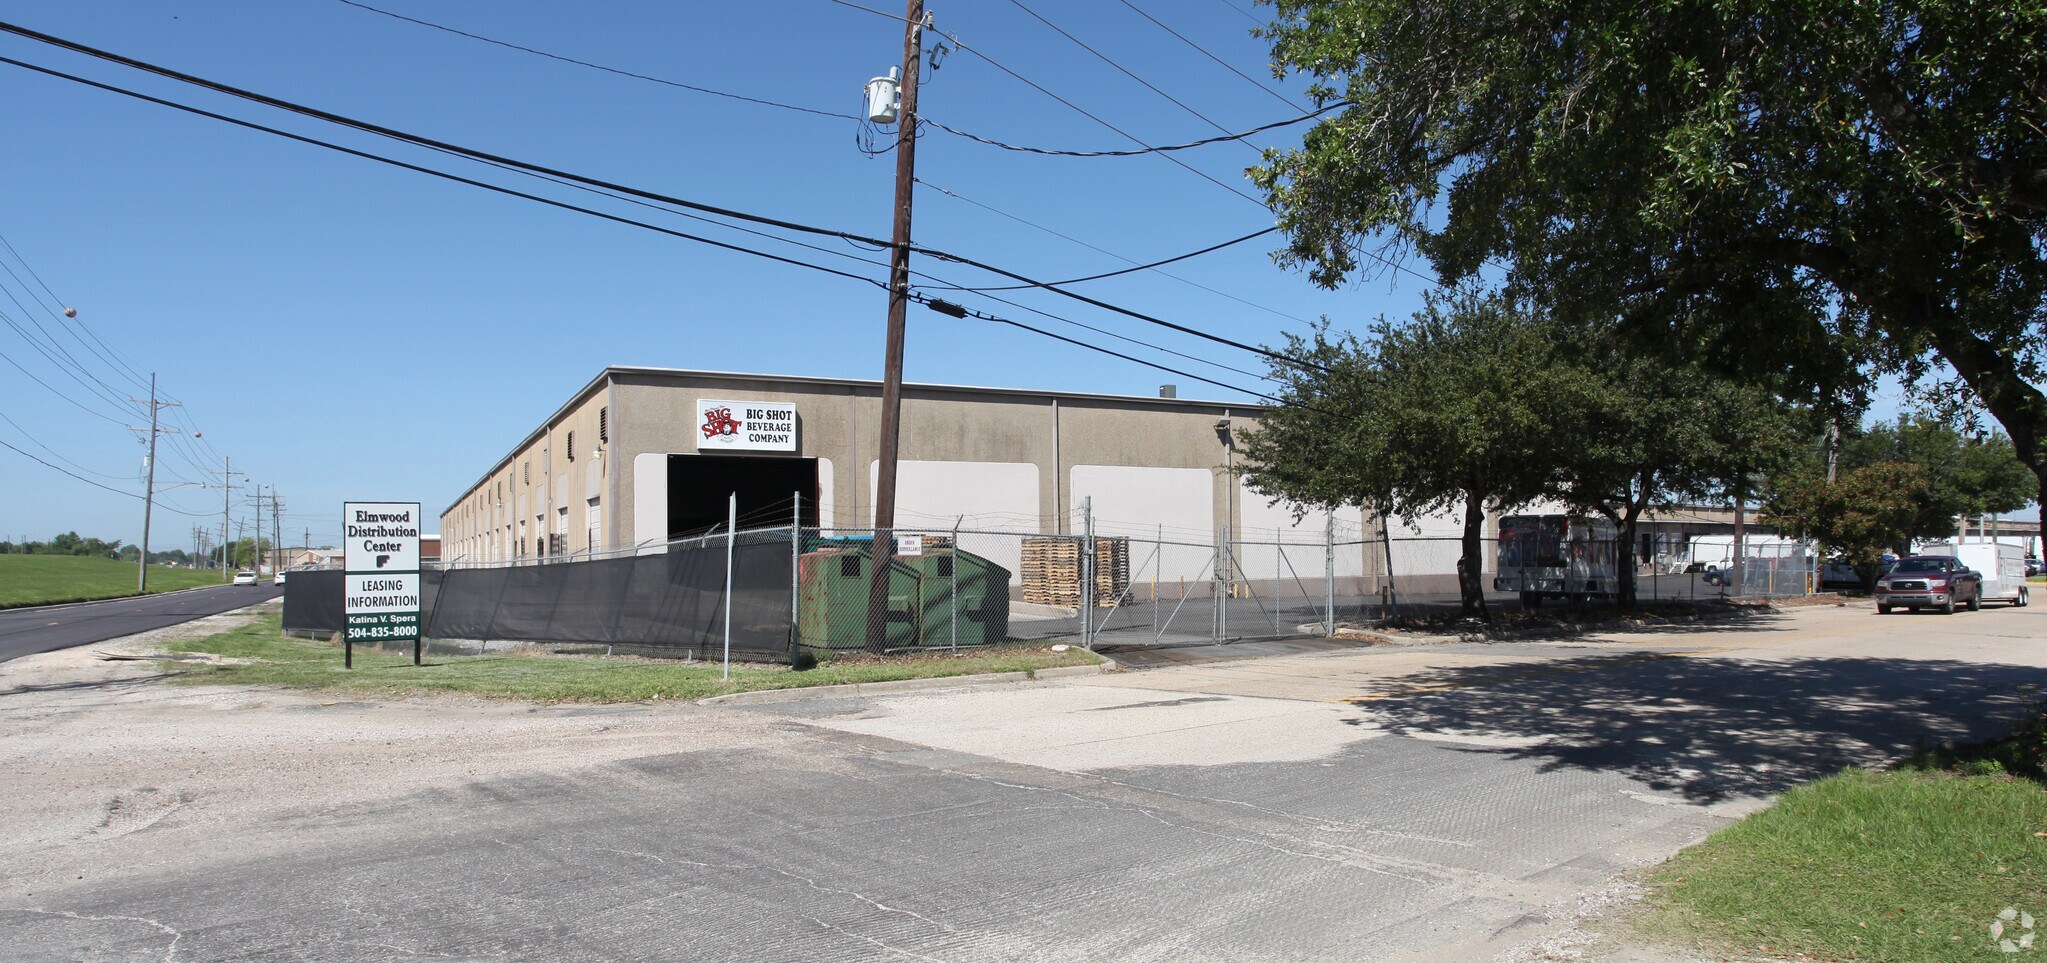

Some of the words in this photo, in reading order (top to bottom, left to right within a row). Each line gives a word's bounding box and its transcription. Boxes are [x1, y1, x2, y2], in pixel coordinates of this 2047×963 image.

[704, 408, 731, 422] BIG
[746, 409, 763, 420] BIG
[766, 409, 792, 420] SHOT
[701, 418, 742, 439] SHOT
[747, 422, 792, 432] BEVERAGE
[749, 433, 789, 443] COMPANY
[356, 510, 409, 522] Elmwood
[348, 525, 417, 537] Distribution
[364, 540, 402, 552] Center
[362, 580, 403, 592] LEASING
[348, 595, 417, 608] INFORMATION
[349, 615, 378, 624] Katina
[380, 615, 388, 623] V.
[390, 615, 416, 624] Spera
[348, 626, 417, 638] 504-835-8000
